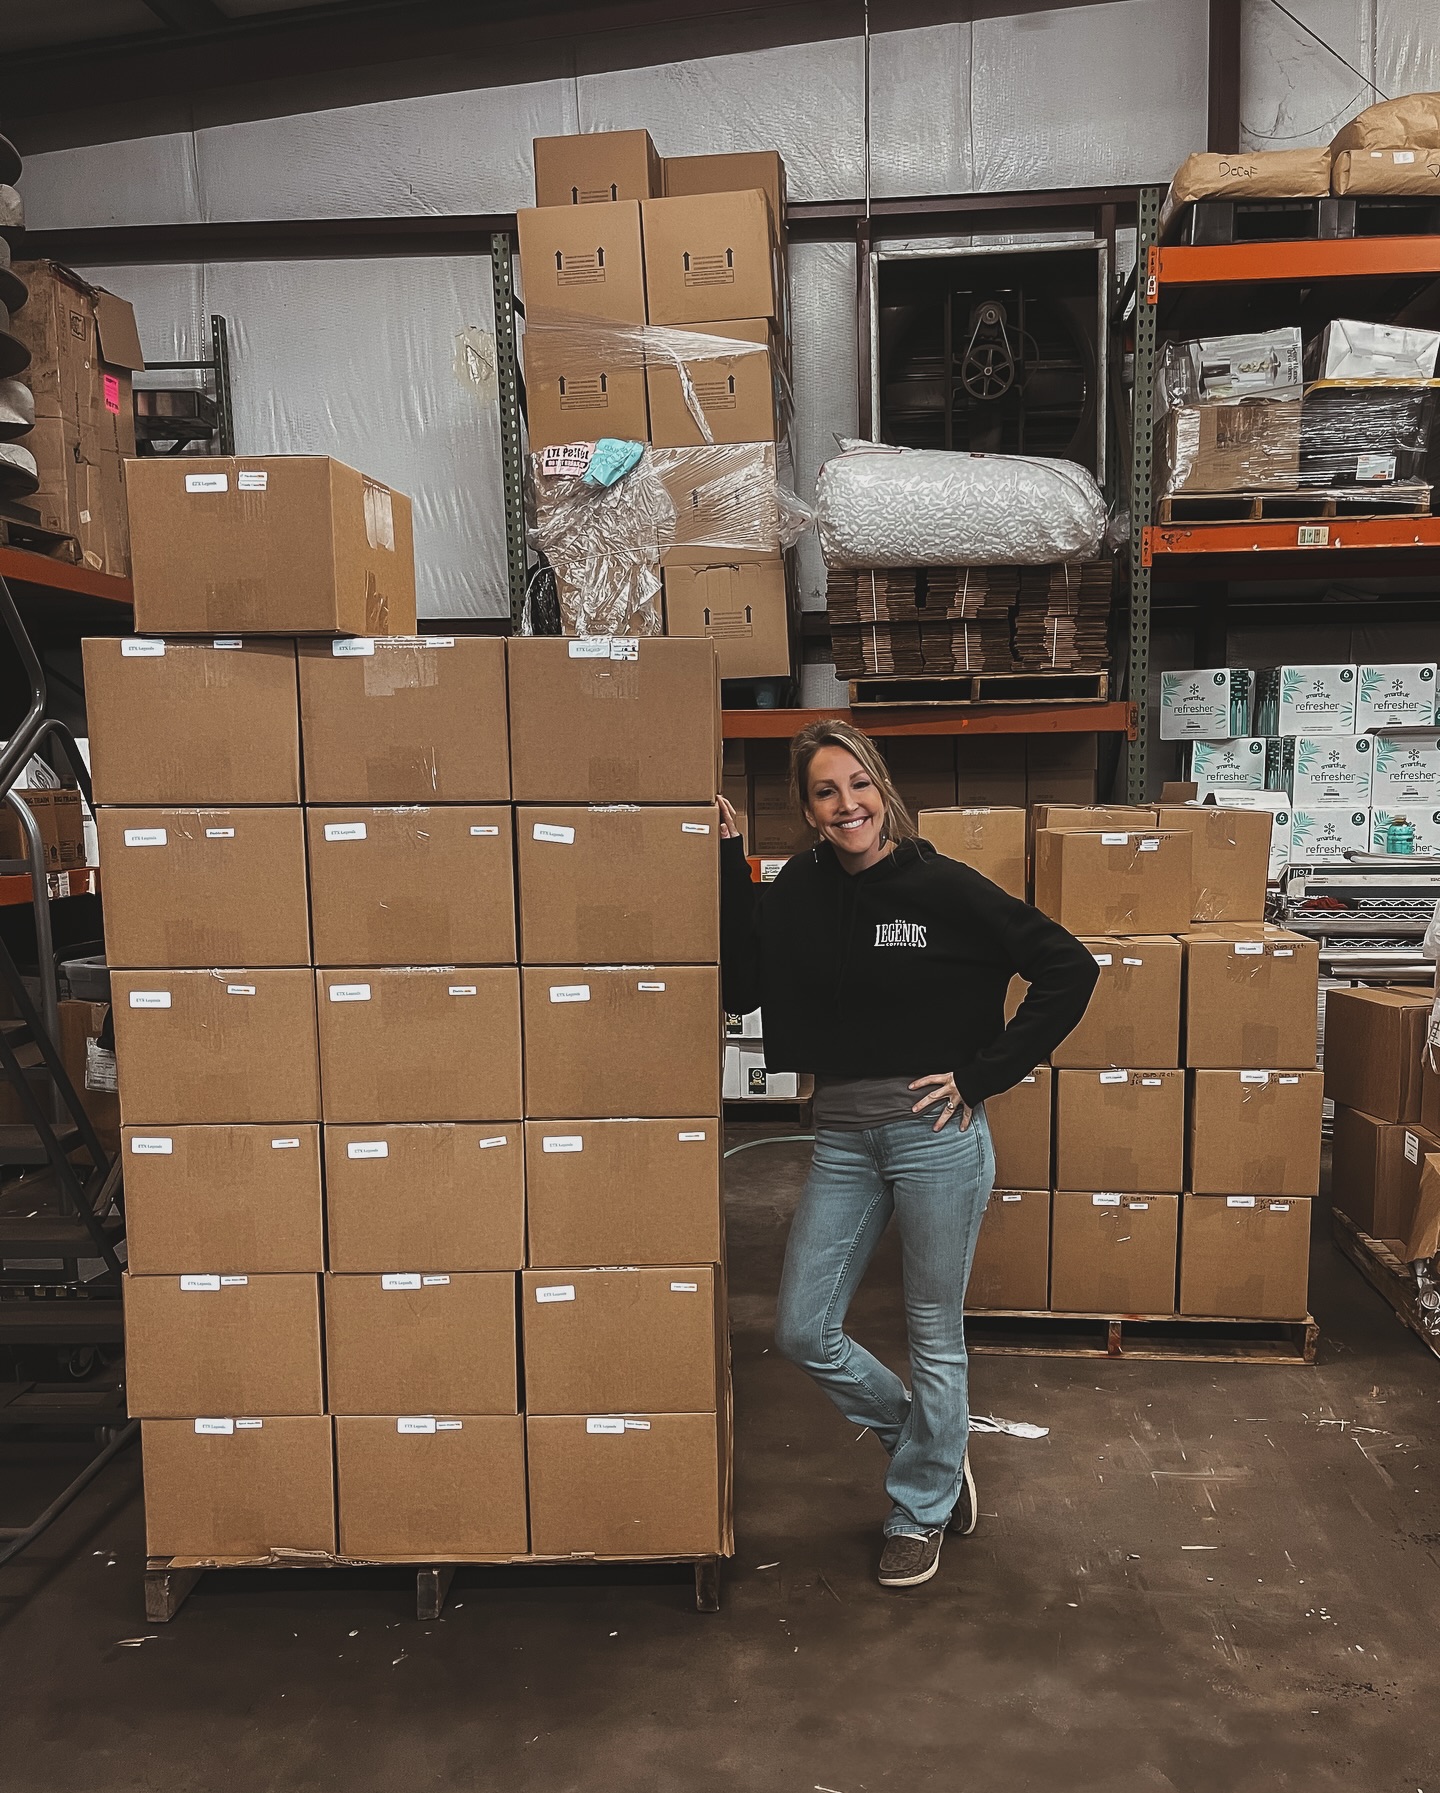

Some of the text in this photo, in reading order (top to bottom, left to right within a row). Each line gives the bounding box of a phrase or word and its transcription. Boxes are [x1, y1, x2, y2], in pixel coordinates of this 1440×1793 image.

[1173, 704, 1214, 714] refresher
[1295, 701, 1340, 711] refresher
[1373, 701, 1419, 711] refresher
[1206, 772, 1250, 782] refresher
[1310, 771, 1356, 781] refresher
[1389, 770, 1437, 780] refresher
[1305, 845, 1352, 854] refresher
[874, 923, 927, 948] LEGENDS
